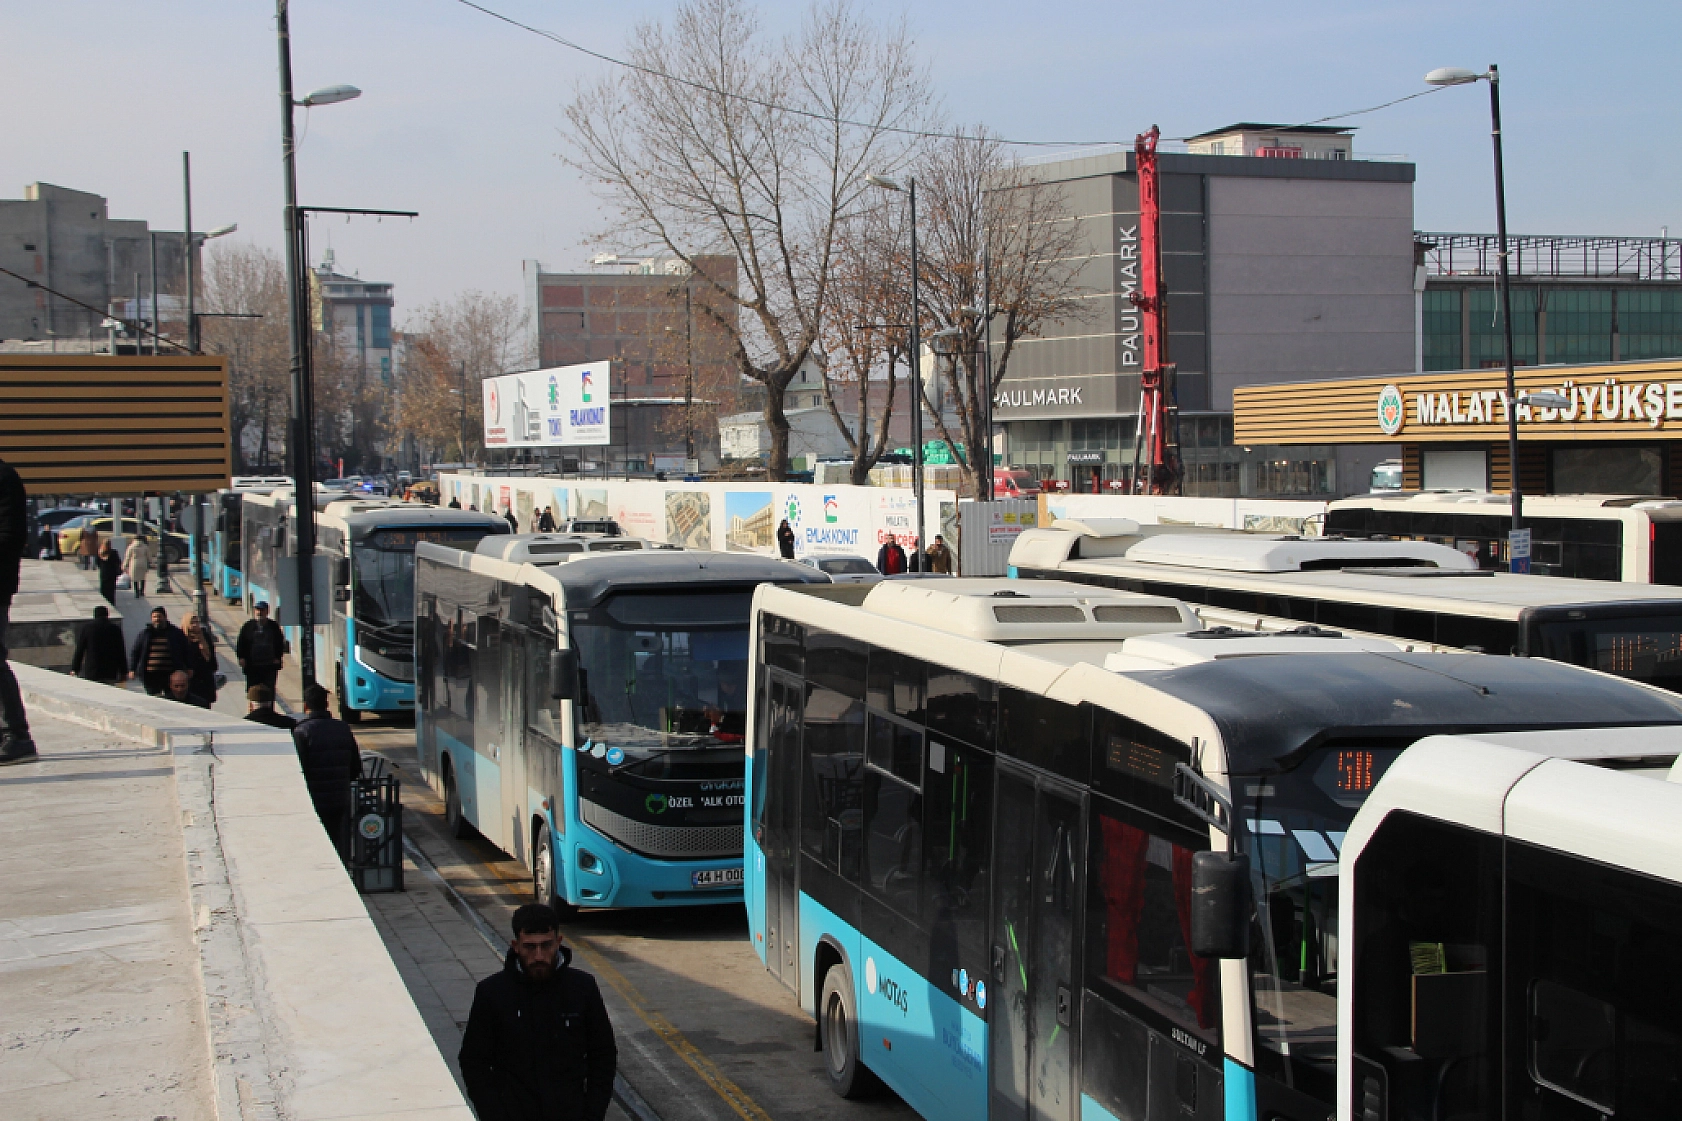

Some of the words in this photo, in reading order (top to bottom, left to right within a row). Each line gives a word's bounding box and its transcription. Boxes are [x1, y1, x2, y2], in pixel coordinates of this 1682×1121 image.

[1119, 224, 1139, 367] PAULMARK
[1416, 391, 1531, 424] MALATYA
[668, 795, 694, 808] ÖZEL
[879, 972, 908, 1018] MOTAŞ
